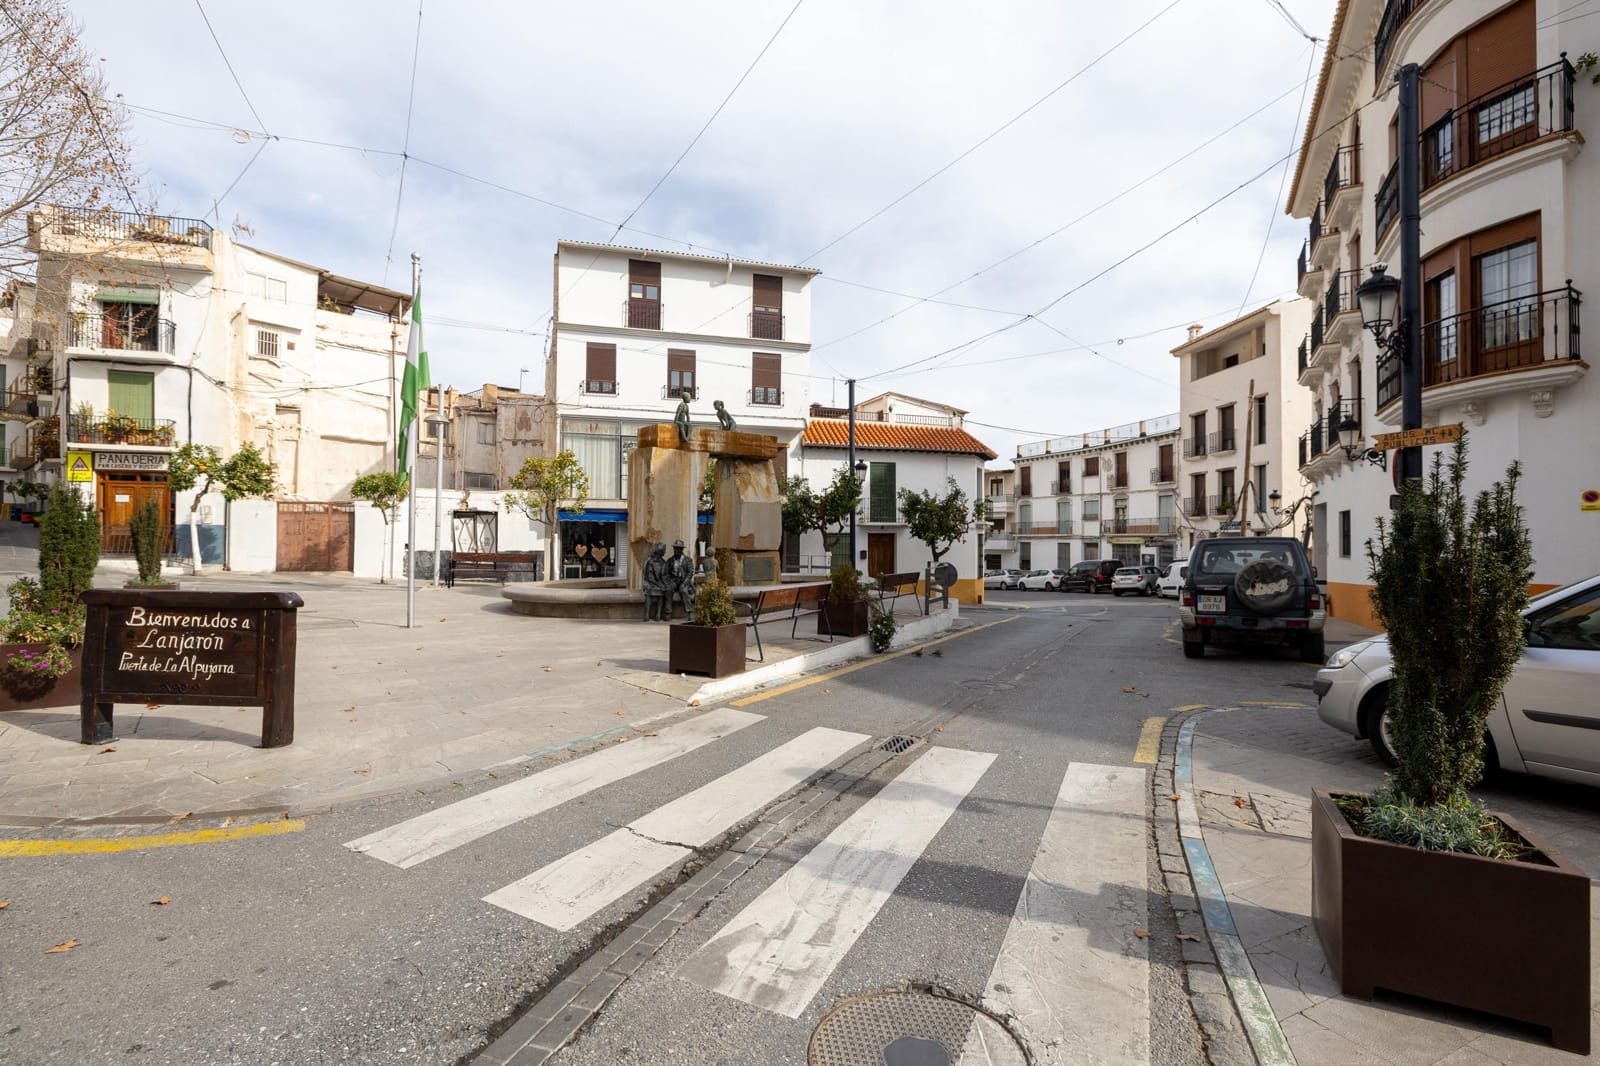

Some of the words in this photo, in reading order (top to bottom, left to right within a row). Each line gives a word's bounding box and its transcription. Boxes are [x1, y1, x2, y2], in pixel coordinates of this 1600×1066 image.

[1383, 431, 1416, 441] ASEOS
[98, 454, 165, 465] PANADERIA
[125, 606, 237, 628] Bienvenidos
[241, 619, 250, 629] a
[137, 629, 224, 655] Lanjarón
[118, 651, 149, 671] Puerta
[149, 656, 161, 671] de
[163, 657, 177, 672] La
[178, 655, 235, 680] Alpujarra
